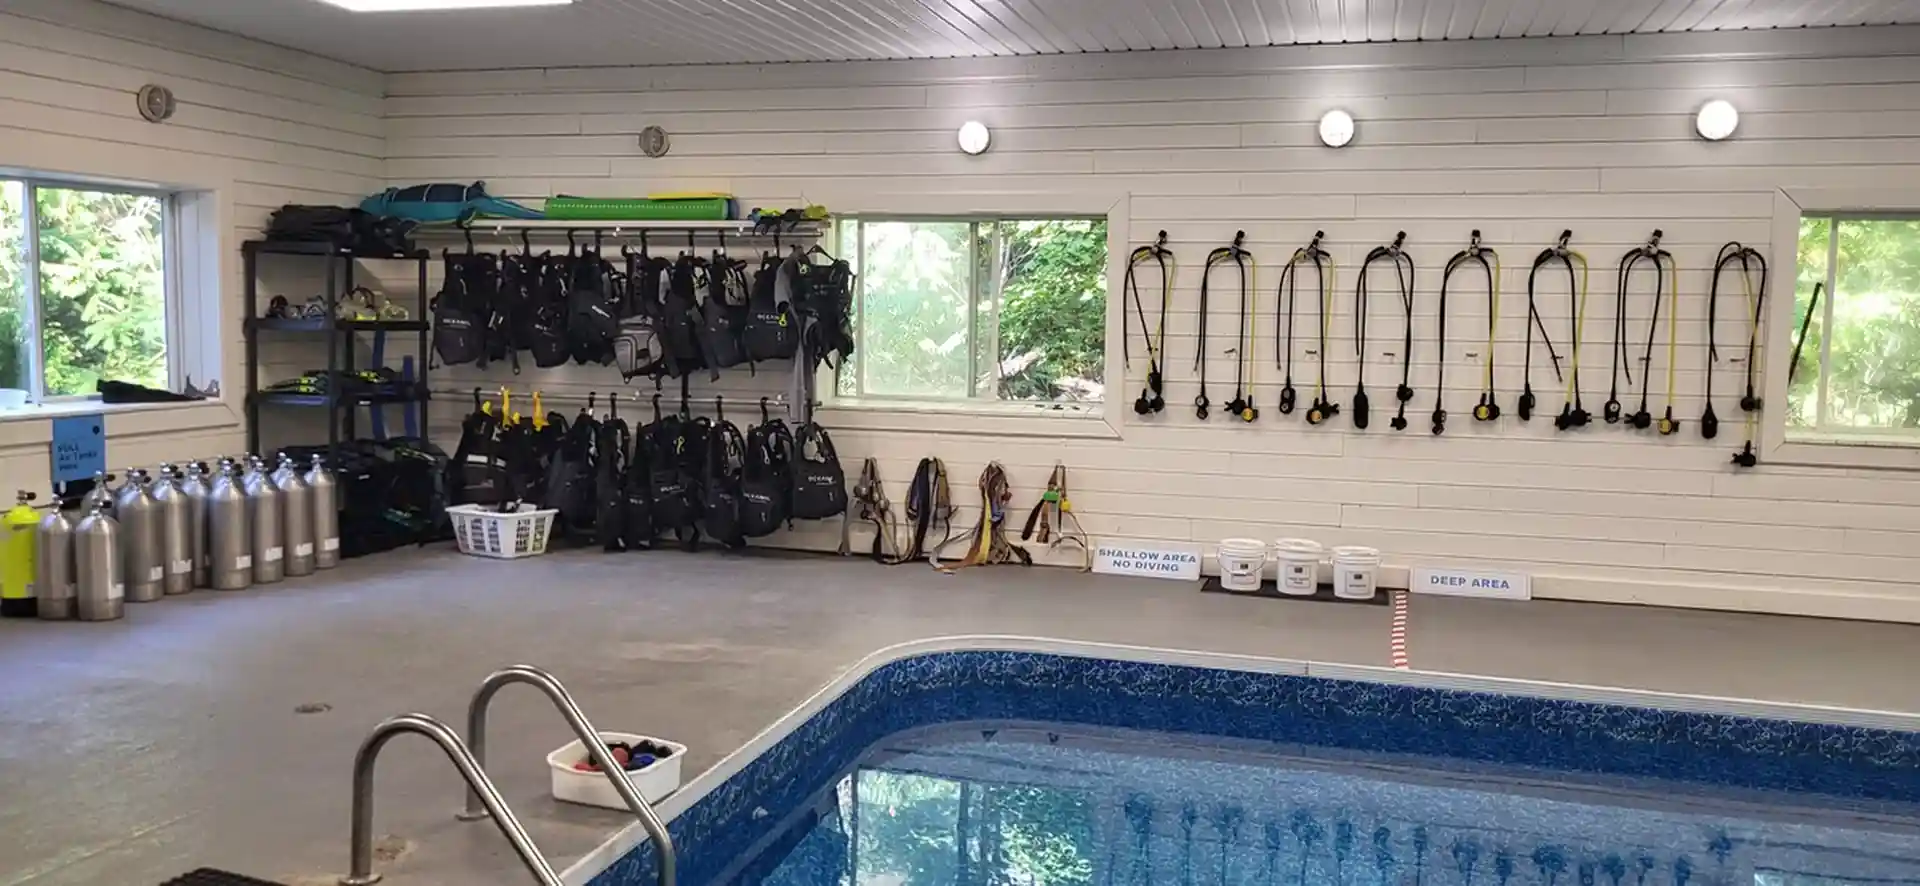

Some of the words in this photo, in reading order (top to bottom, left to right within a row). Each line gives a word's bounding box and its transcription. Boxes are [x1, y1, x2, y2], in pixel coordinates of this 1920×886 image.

[1099, 548, 1159, 560] SHALLOW
[1163, 553, 1196, 563] AREA
[1113, 560, 1130, 568] NO
[1135, 561, 1179, 571] DIVING
[1431, 575, 1466, 586] DEEP
[1471, 578, 1510, 589] AREA
